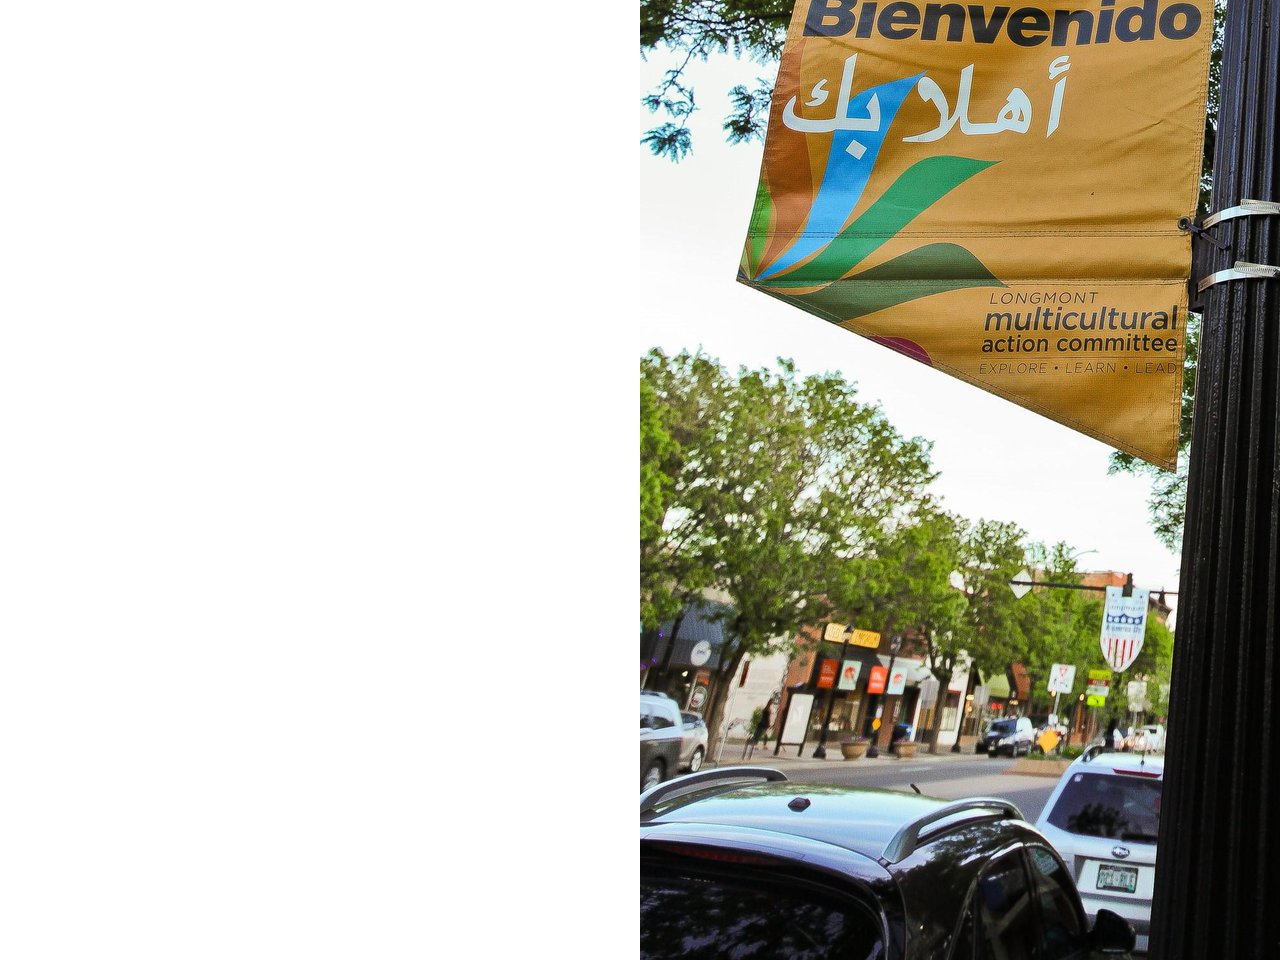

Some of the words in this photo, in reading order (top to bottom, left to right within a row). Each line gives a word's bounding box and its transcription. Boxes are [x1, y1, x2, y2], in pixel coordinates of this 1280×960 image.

[989, 291, 1099, 305] LONGMONT
[984, 304, 1178, 332] multicultural
[981, 334, 1049, 353] action
[1056, 333, 1178, 352] committee
[979, 362, 1048, 375] EXPLORE
[1065, 361, 1117, 374] LEARN
[1135, 361, 1177, 374] LEAD
